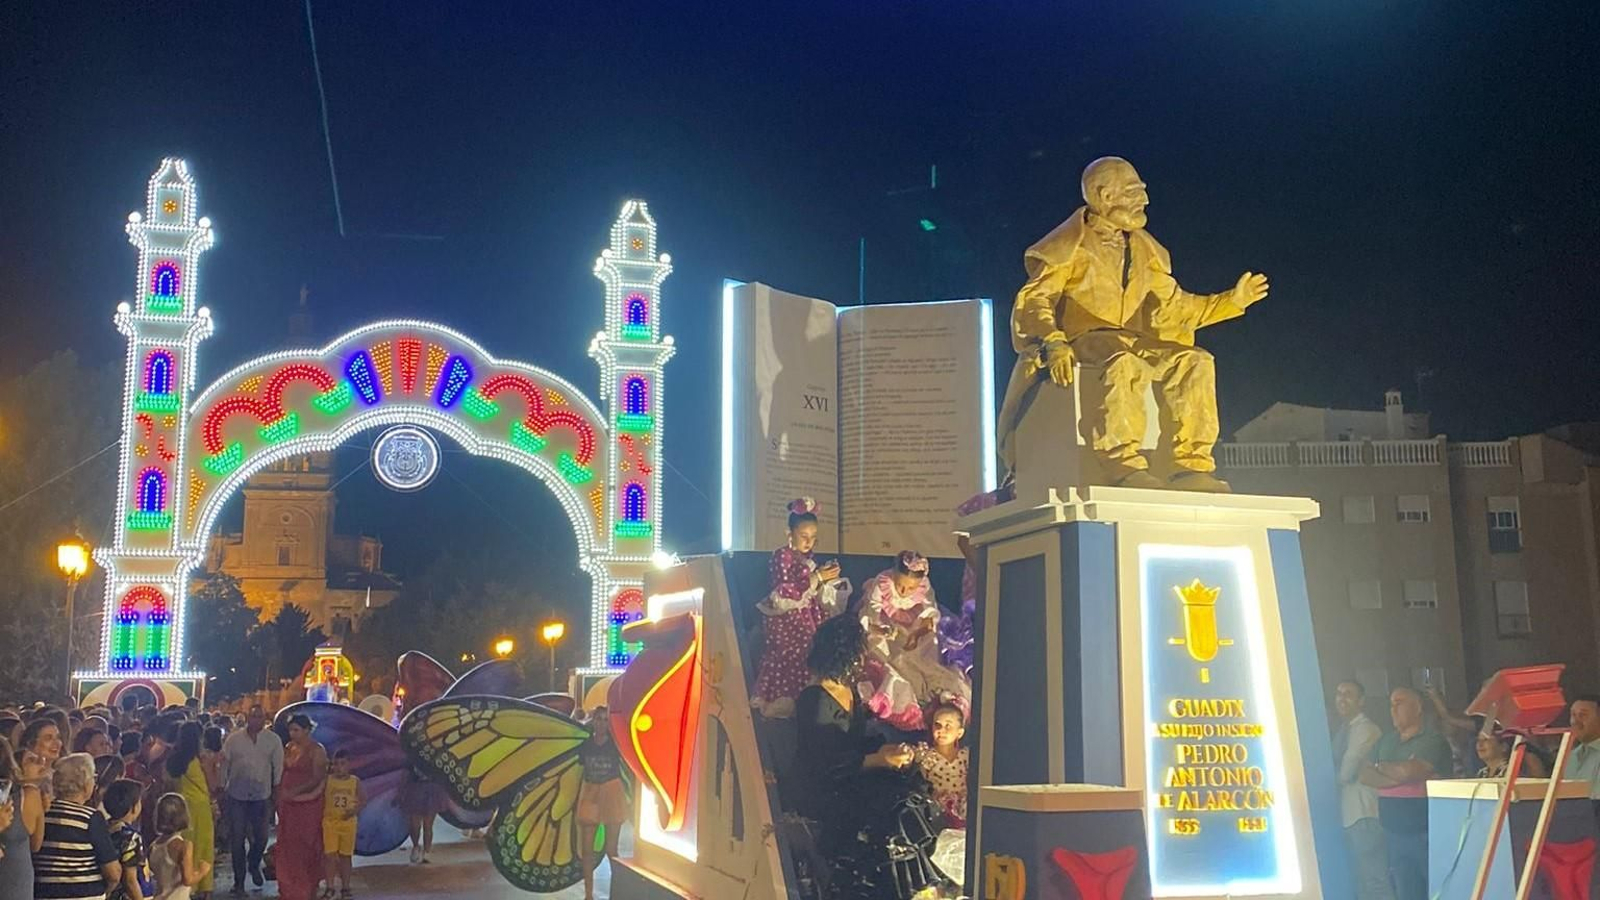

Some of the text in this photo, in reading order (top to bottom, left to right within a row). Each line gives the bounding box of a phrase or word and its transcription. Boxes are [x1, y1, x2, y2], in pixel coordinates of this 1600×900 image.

[802, 394, 828, 412] XVI
[1168, 698, 1245, 718] GUADIX
[1176, 743, 1248, 764] PEDRO
[1164, 767, 1264, 788] ANTONIO
[334, 796, 347, 807] 23
